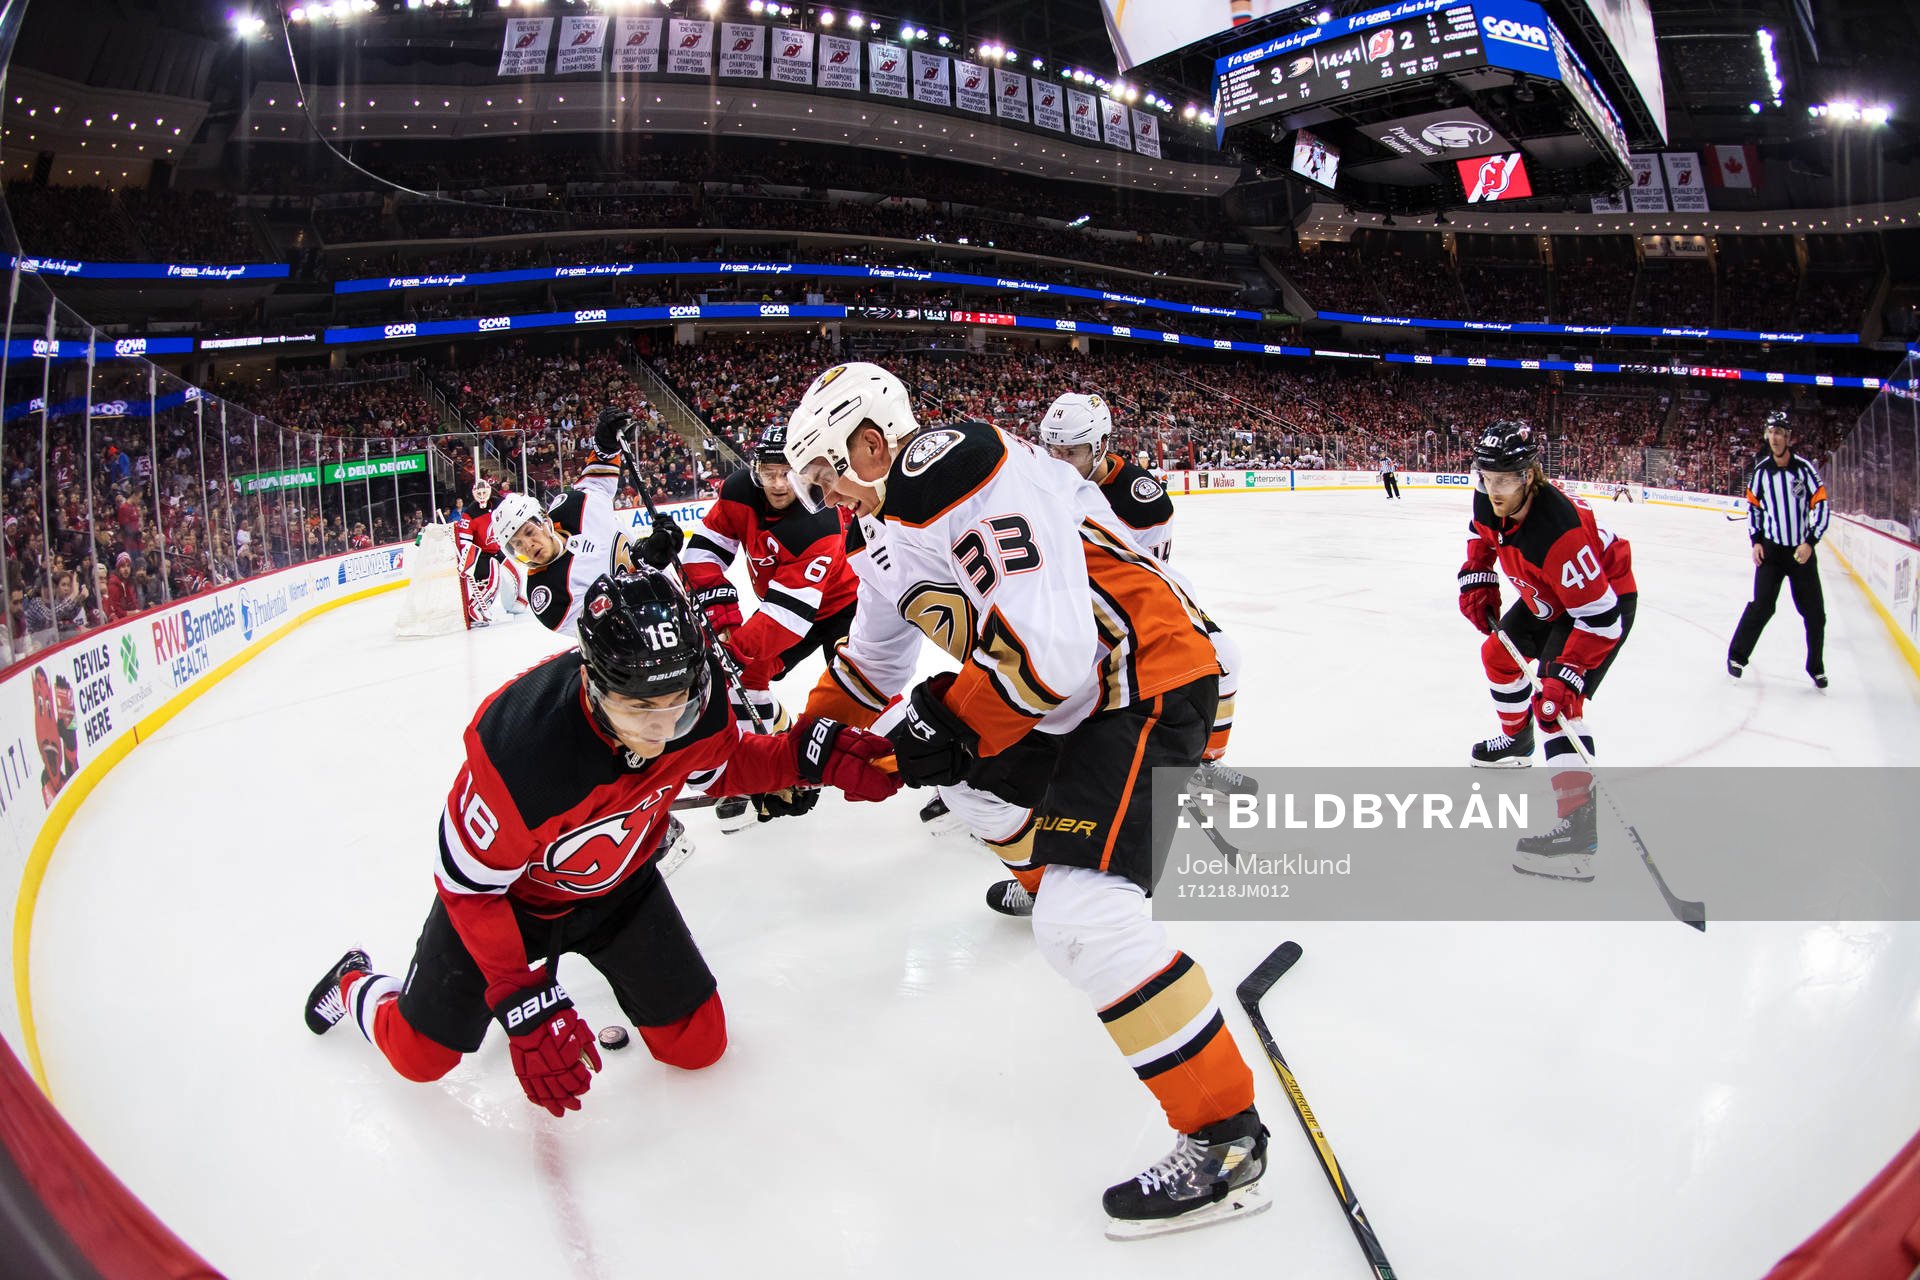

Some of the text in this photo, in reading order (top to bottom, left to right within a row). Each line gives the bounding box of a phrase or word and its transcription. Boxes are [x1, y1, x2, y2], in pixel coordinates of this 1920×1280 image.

[1482, 16, 1548, 46] GOYA
[1271, 31, 1415, 85] 3 14:41 2
[1381, 67, 1393, 78] 23
[1406, 67, 1417, 76] 63
[1341, 80, 1349, 90] 3
[1300, 89, 1310, 98] 19
[1379, 135, 1413, 154] Center
[1388, 126, 1439, 157] Prudential
[574, 309, 606, 321] GOYA
[669, 305, 700, 316] GOYA
[760, 304, 790, 315] GOYA
[896, 309, 947, 318] 3 14:41
[479, 317, 510, 329] GOYA
[965, 313, 972, 322] 2
[1055, 319, 1076, 329] GOYA
[384, 323, 416, 336] GOYA
[1112, 326, 1131, 335] GOYA
[1163, 332, 1180, 341] GOYA
[115, 338, 147, 355] GOYA
[1213, 339, 1232, 348] GOYA
[1264, 344, 1281, 352] GOYA
[1053, 408, 1064, 419] 14
[773, 433, 783, 442] 6
[348, 458, 418, 477] DELTA DENTAL
[1213, 477, 1235, 488] Wawa
[1249, 474, 1287, 484] enterprise
[1436, 475, 1469, 485] GEICO
[631, 503, 705, 528] Atntic
[952, 513, 1043, 599] 33
[345, 551, 392, 581] HALMAR
[804, 555, 832, 583] 6
[1560, 544, 1601, 590] 40
[253, 587, 288, 627] Prudential
[151, 596, 236, 666] RWJBarnabas
[645, 621, 679, 651] 16
[73, 643, 111, 684] DEVILS
[171, 645, 209, 688] HEALTH
[647, 667, 688, 682] BAUER
[78, 673, 115, 715] CHECK
[84, 708, 113, 748] HERE
[506, 982, 570, 1029] BAUE
[1287, 1078, 1319, 1127] SUPREME
